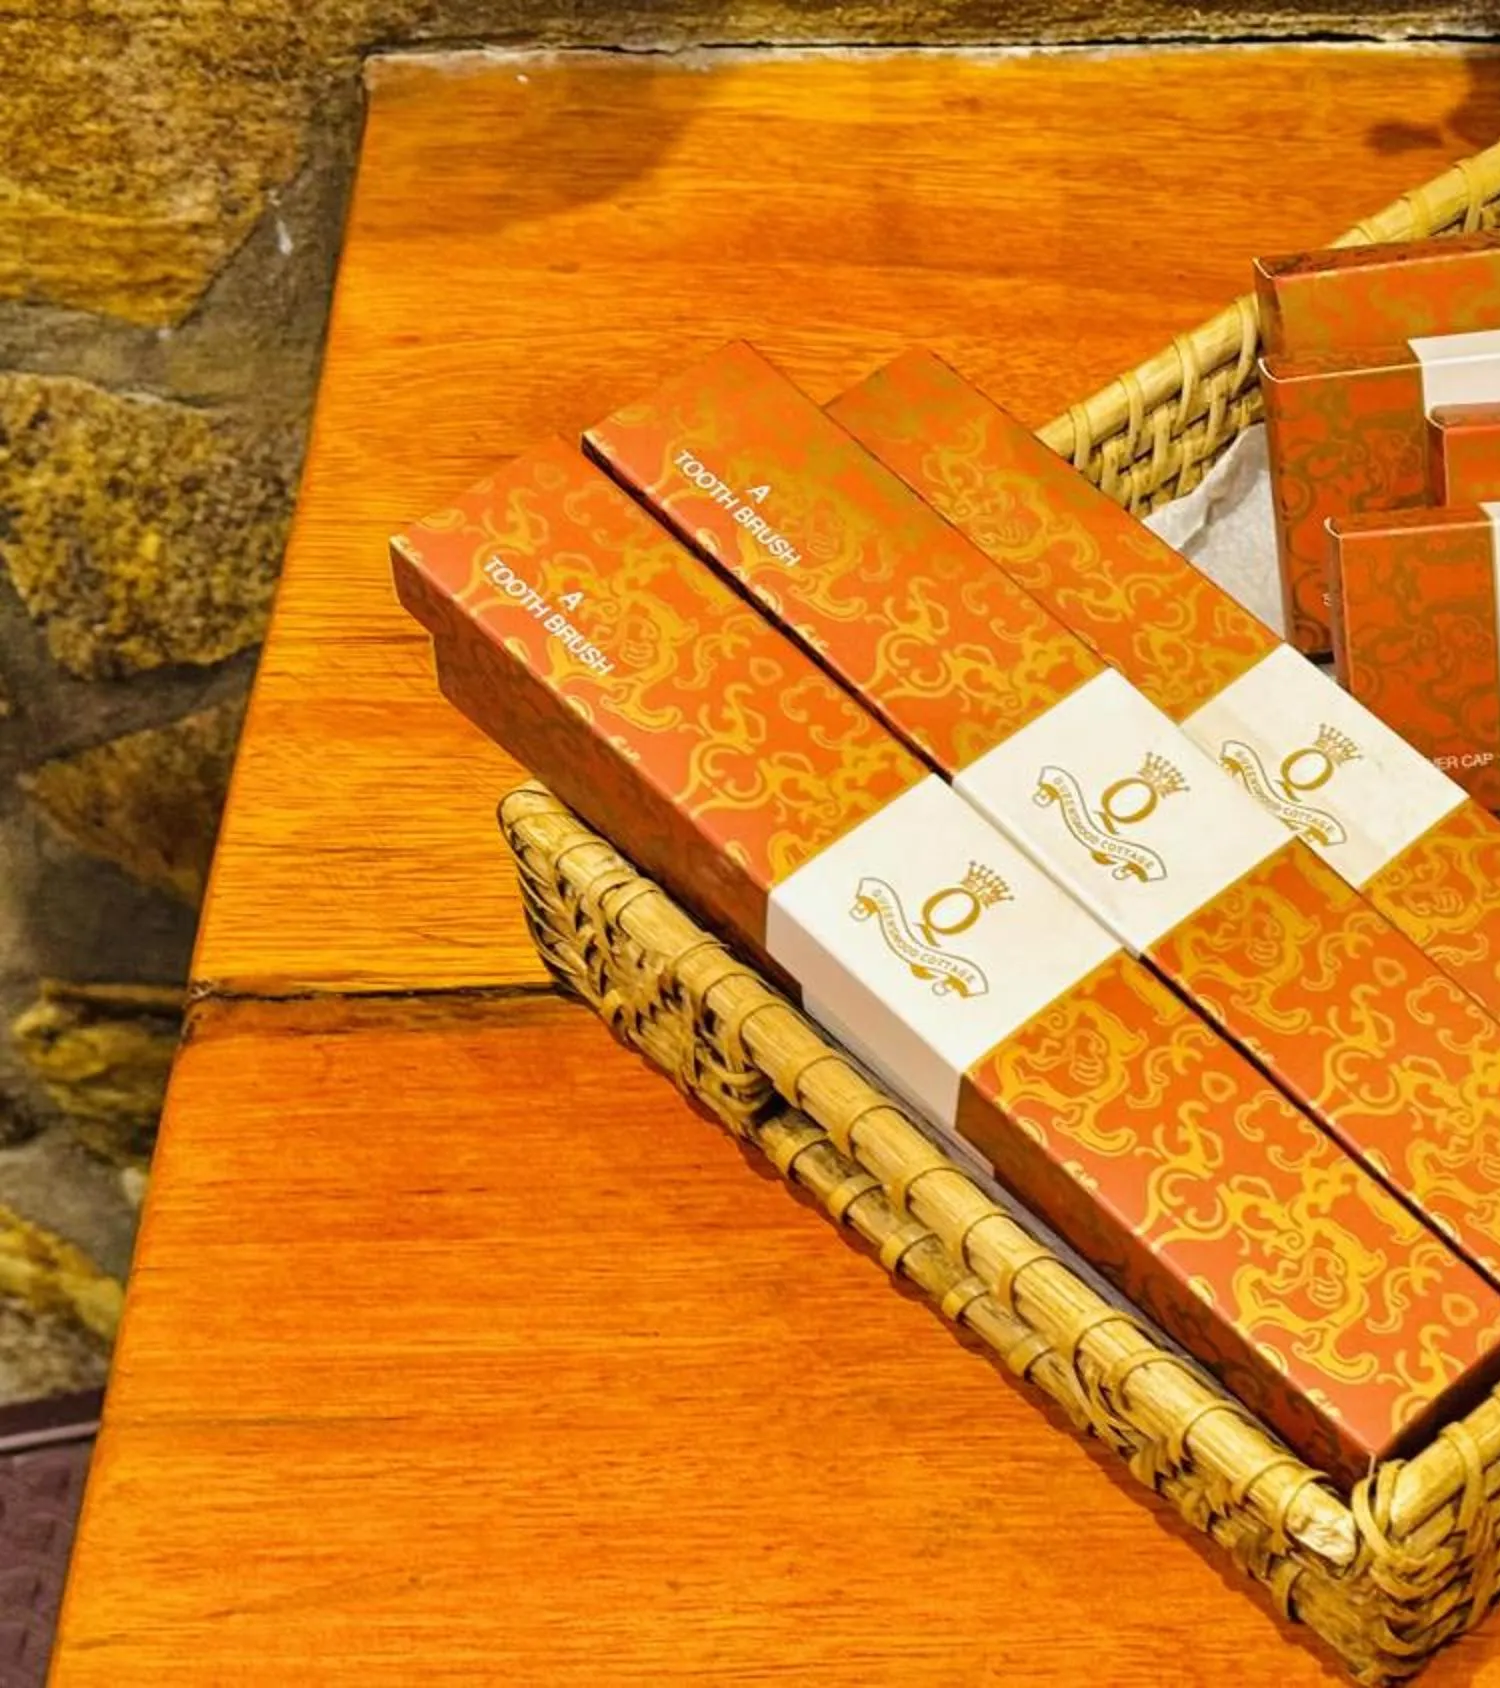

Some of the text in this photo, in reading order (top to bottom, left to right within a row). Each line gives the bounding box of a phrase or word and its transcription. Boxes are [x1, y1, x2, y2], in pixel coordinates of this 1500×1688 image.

[673, 449, 802, 568] TOOTH BRUSH
[748, 484, 772, 504] A
[482, 554, 615, 678] TOOTH BRUSH
[558, 590, 585, 611] A
[1274, 749, 1334, 803] Q
[1461, 752, 1494, 768] CAP
[1092, 777, 1158, 834] Q
[1282, 806, 1336, 833] COTTAGE
[1100, 839, 1155, 870] COTTAGE
[912, 887, 981, 948] Q
[921, 952, 976, 985] COTTAGE
